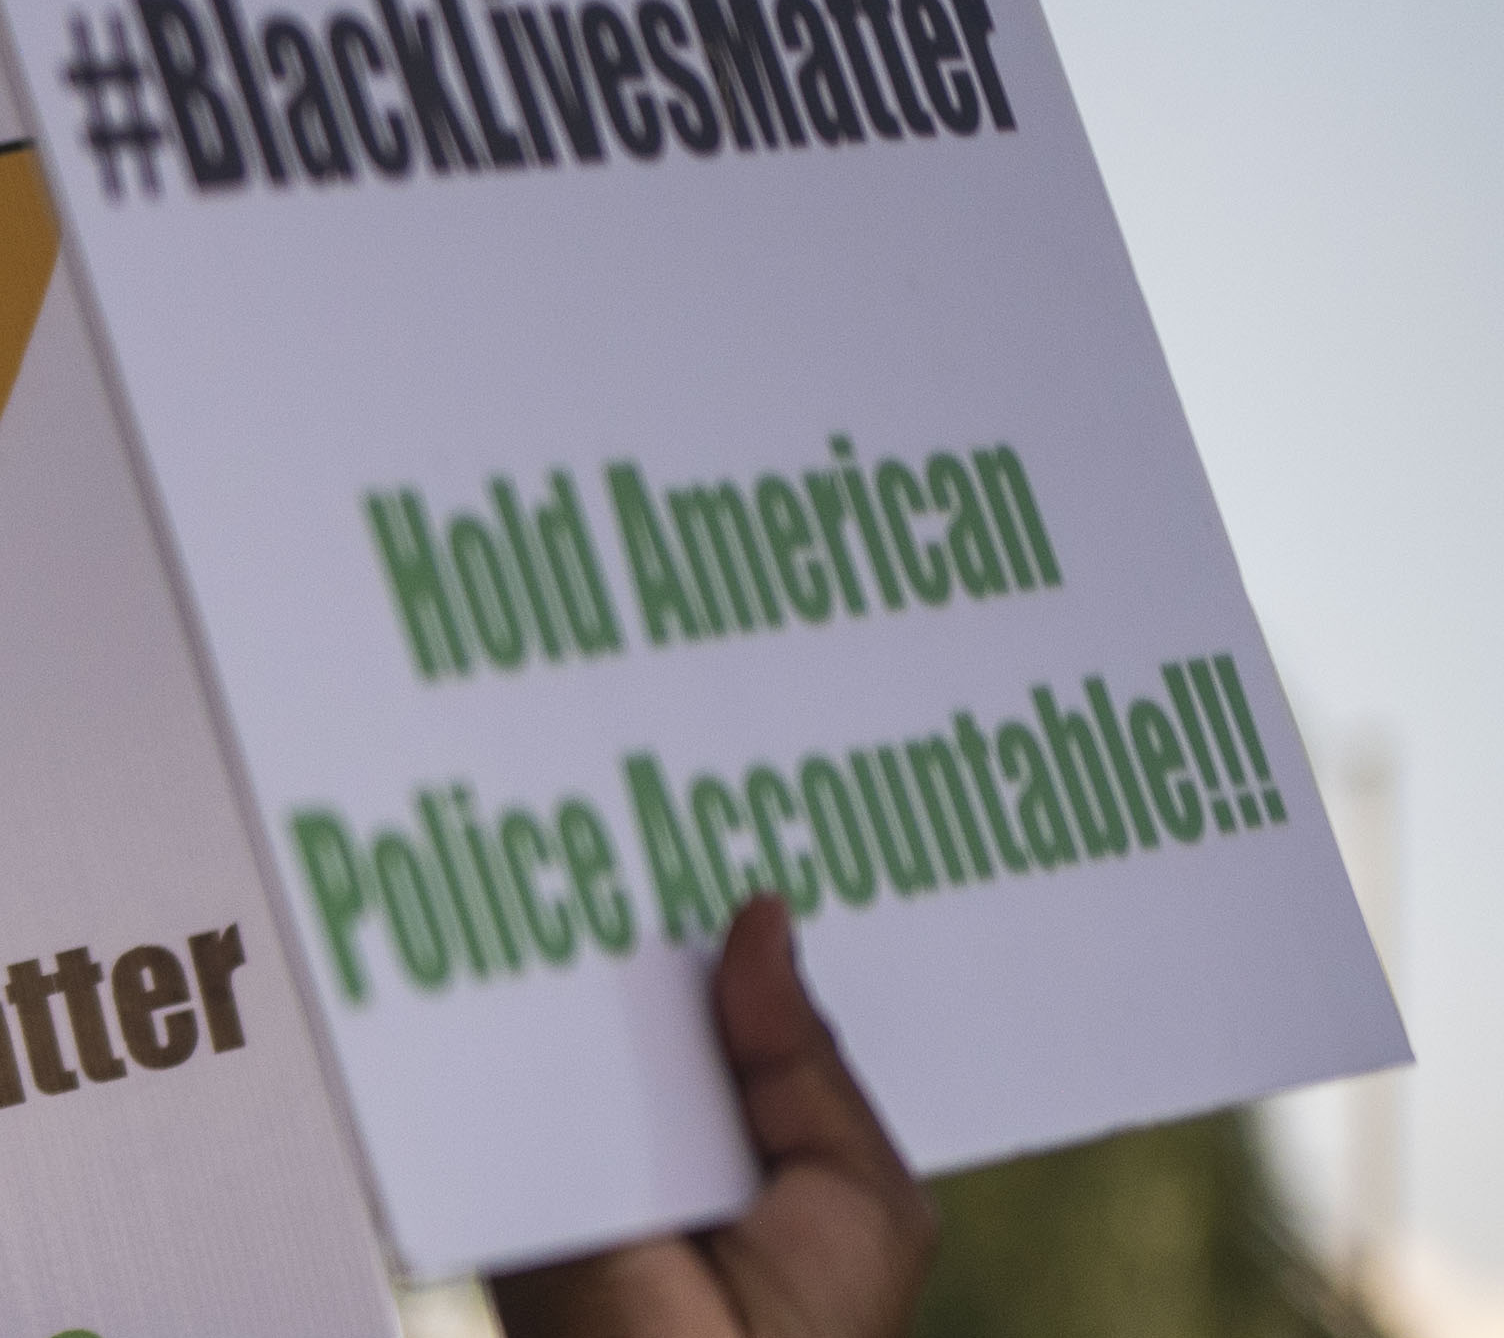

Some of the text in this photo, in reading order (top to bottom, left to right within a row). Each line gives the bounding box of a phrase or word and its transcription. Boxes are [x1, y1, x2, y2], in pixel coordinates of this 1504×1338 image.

[362, 433, 1064, 683] Hold American
[288, 651, 1288, 1009] Police Accountable!!!
